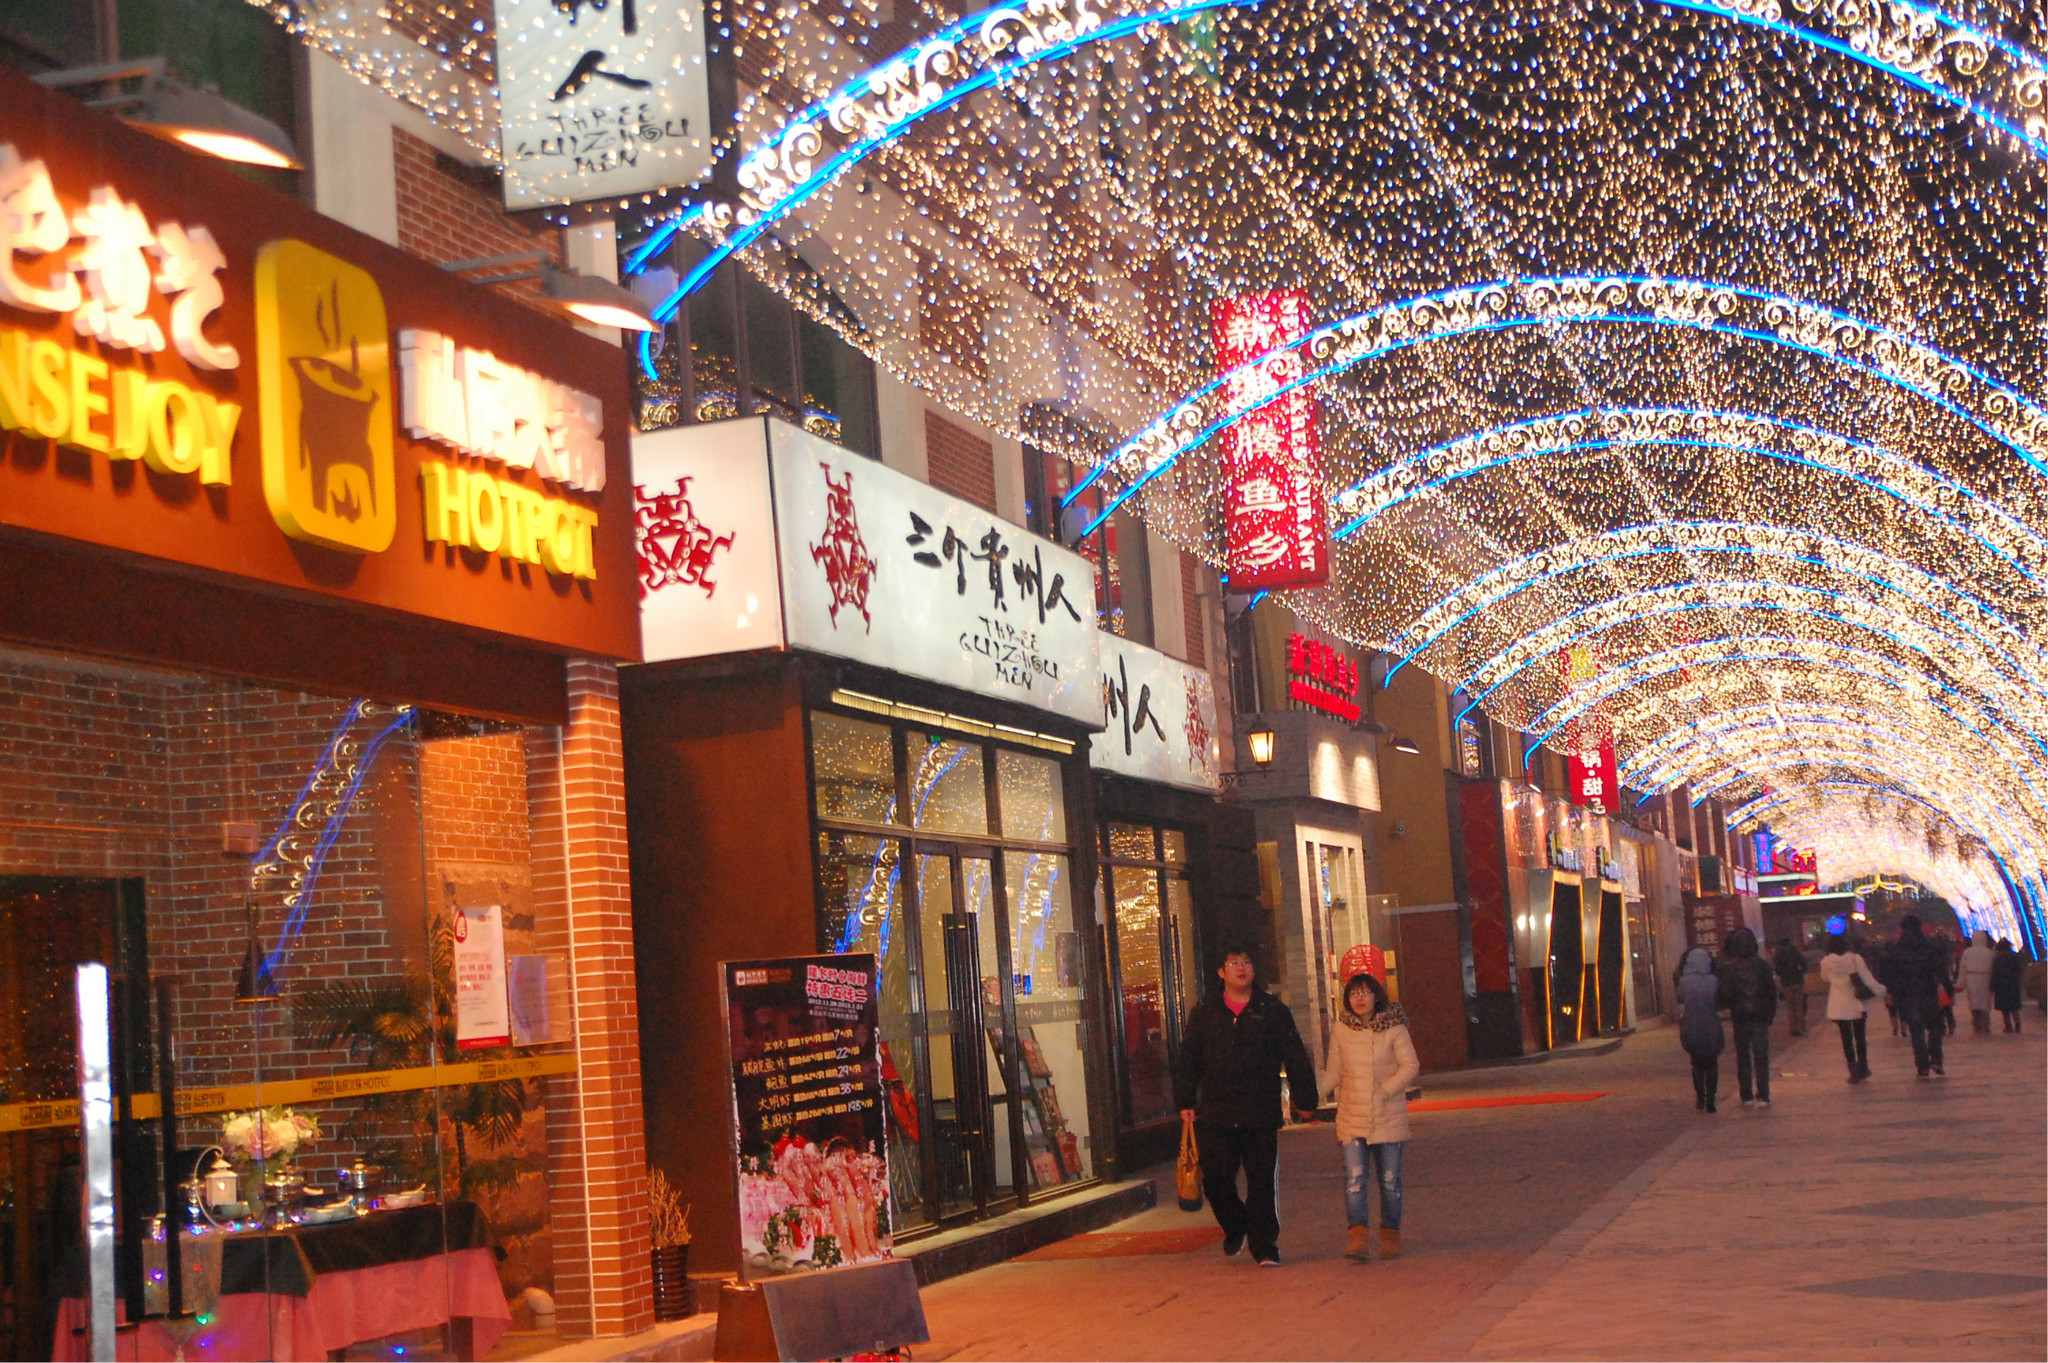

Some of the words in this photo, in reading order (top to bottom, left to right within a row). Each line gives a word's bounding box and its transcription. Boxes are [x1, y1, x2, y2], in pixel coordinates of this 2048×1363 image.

[547, 103, 655, 133] THREE
[517, 118, 690, 161] GUIZHOU
[573, 150, 639, 174] MEN
[421, 462, 598, 580] HOTPOT
[978, 615, 1039, 652] THREE
[959, 632, 1060, 681] GUIZHOU
[995, 662, 1033, 691] MEN
